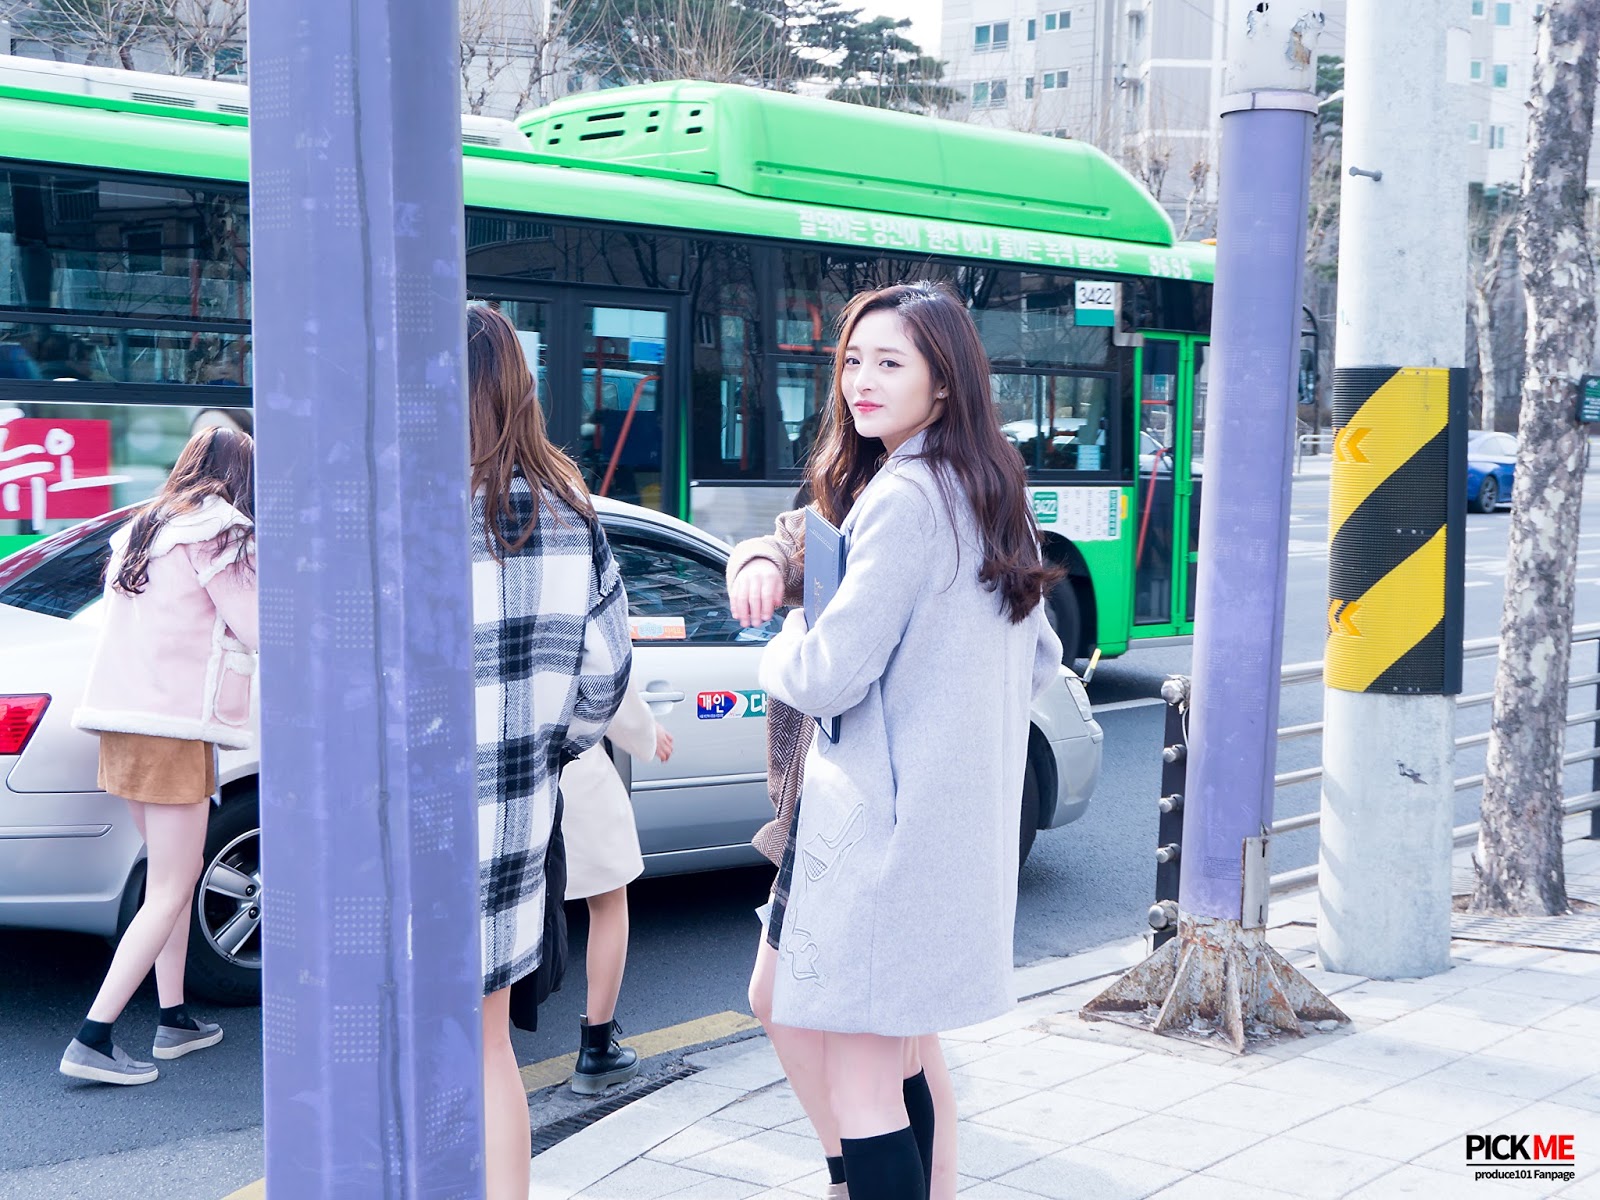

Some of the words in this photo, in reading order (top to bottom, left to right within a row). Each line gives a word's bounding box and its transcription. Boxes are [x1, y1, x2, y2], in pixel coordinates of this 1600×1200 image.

[962, 229, 994, 257] 하나
[1079, 286, 1112, 305] 3422
[698, 693, 725, 714] 개인
